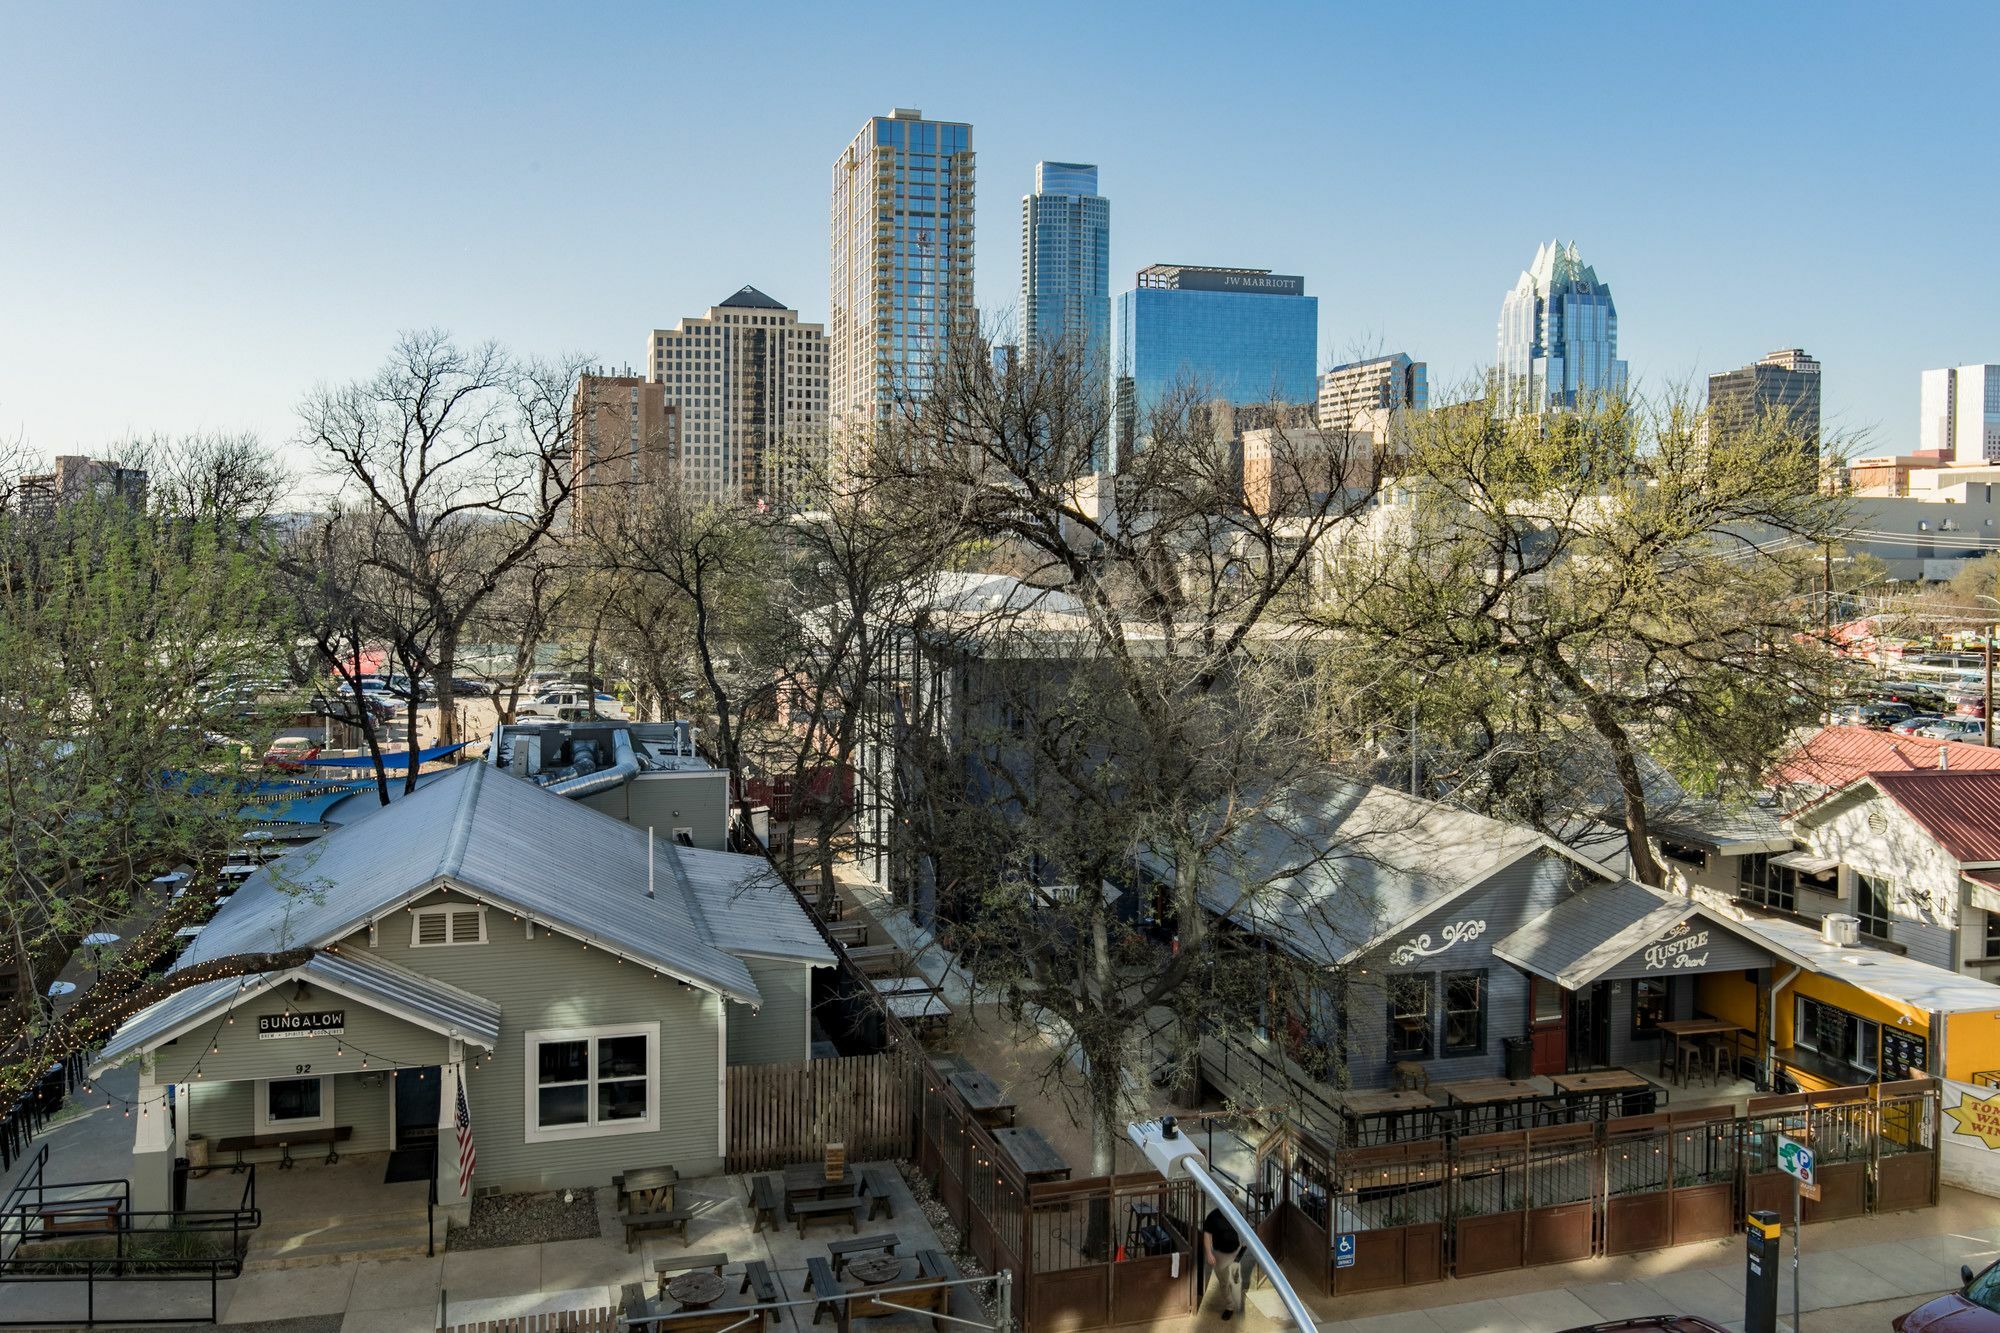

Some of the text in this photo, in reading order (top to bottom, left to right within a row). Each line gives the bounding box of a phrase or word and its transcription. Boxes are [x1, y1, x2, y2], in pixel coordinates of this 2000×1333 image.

[1224, 277, 1296, 288] JW MARRIOTT
[1644, 930, 1709, 971] LUSTRE
[1672, 951, 1710, 969] Pearl
[260, 1013, 342, 1029] BUNGALOW
[284, 1030, 304, 1038] SPIRITS
[295, 1064, 312, 1074] 92
